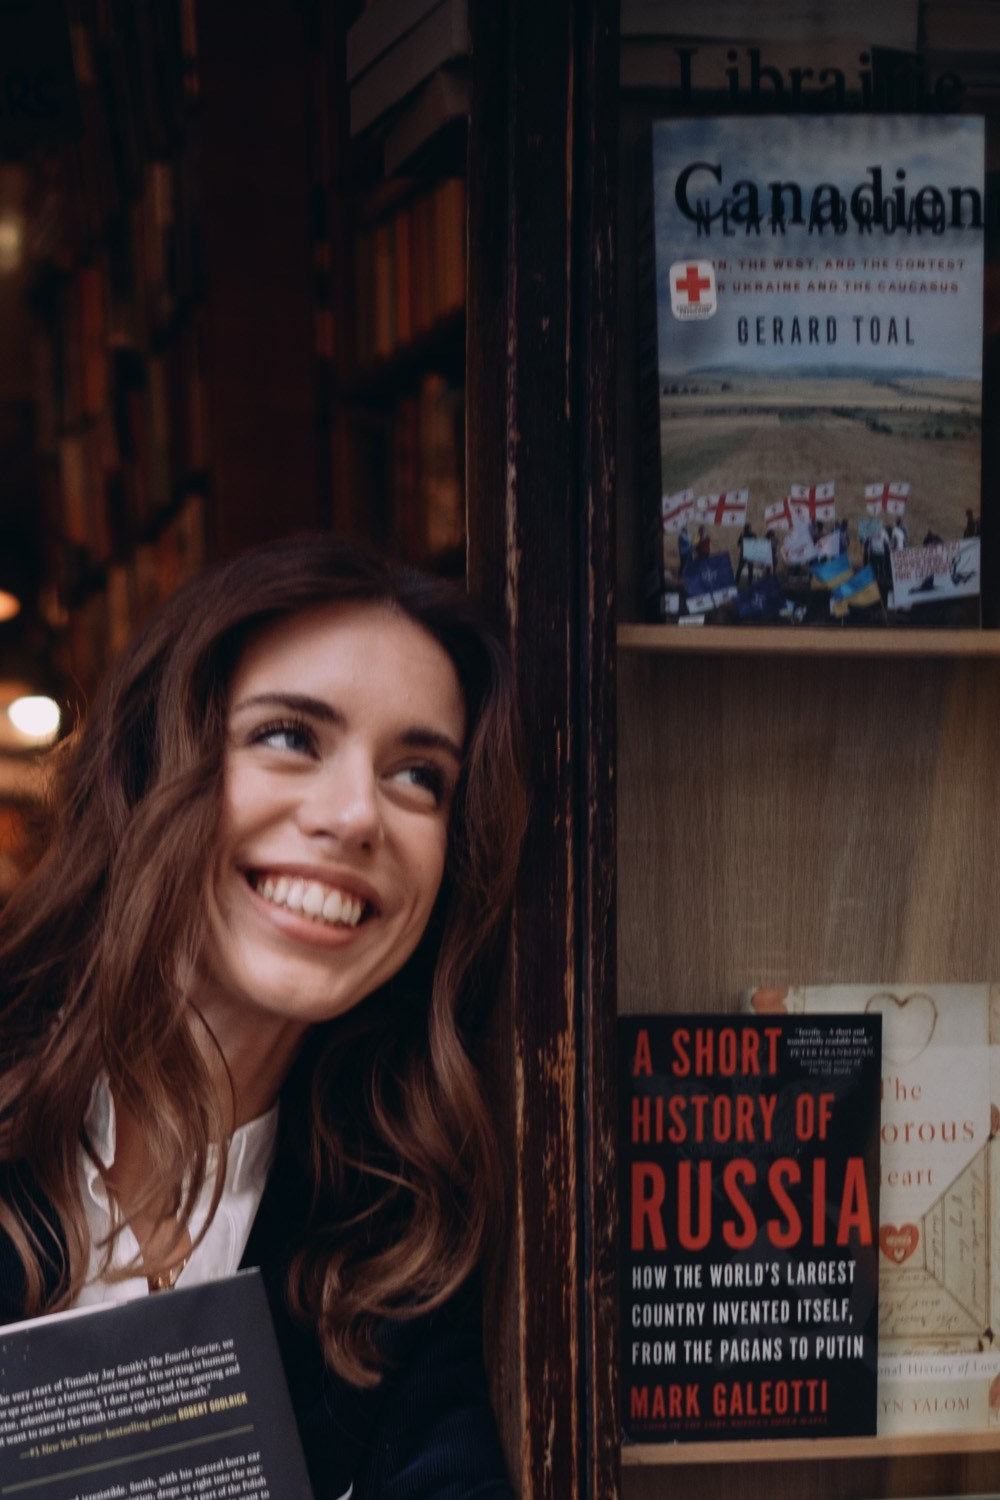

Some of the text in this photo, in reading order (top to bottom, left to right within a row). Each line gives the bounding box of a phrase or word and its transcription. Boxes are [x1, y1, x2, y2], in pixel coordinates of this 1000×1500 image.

[675, 162, 985, 230] Canadien
[740, 259, 766, 272] THE
[863, 258, 890, 271] THE
[732, 280, 801, 294] UKRAINE
[807, 280, 838, 293] AND
[844, 280, 872, 293] THE
[877, 279, 959, 293] CAUCASUS
[738, 314, 915, 347] GERARD TOAL
[632, 1027, 783, 1078] A SHORT
[631, 1092, 835, 1145] HISTORY OF
[881, 1120, 975, 1144] orous
[887, 1167, 934, 1187] eart
[630, 1156, 873, 1252] RUSSIA
[631, 1259, 857, 1290] HOW THE WORLD'S LARGEST
[631, 1302, 706, 1328] COUNTRY
[712, 1300, 790, 1326] INVENTED
[797, 1298, 854, 1324] ITSELF,
[631, 1335, 865, 1366] FROM THE PAGANS TO PUTIN
[11, 1389, 29, 1402] very
[31, 1383, 51, 1397] start
[53, 1379, 62, 1391] of
[63, 1371, 99, 1389] Timothy
[101, 1368, 115, 1380] Jay
[116, 1358, 147, 1376] Smith's
[148, 1355, 162, 1368] The
[164, 1347, 189, 1364] Fourth
[191, 1342, 220, 1357] Courier,
[222, 1338, 233, 1349] we
[178, 1401, 207, 1419] ROBERT
[630, 1379, 829, 1419] MARK GALEOTTI
[910, 1396, 971, 1414] YALOM
[129, 1476, 157, 1493] Smith,
[158, 1470, 177, 1485] with
[178, 1468, 192, 1480] his
